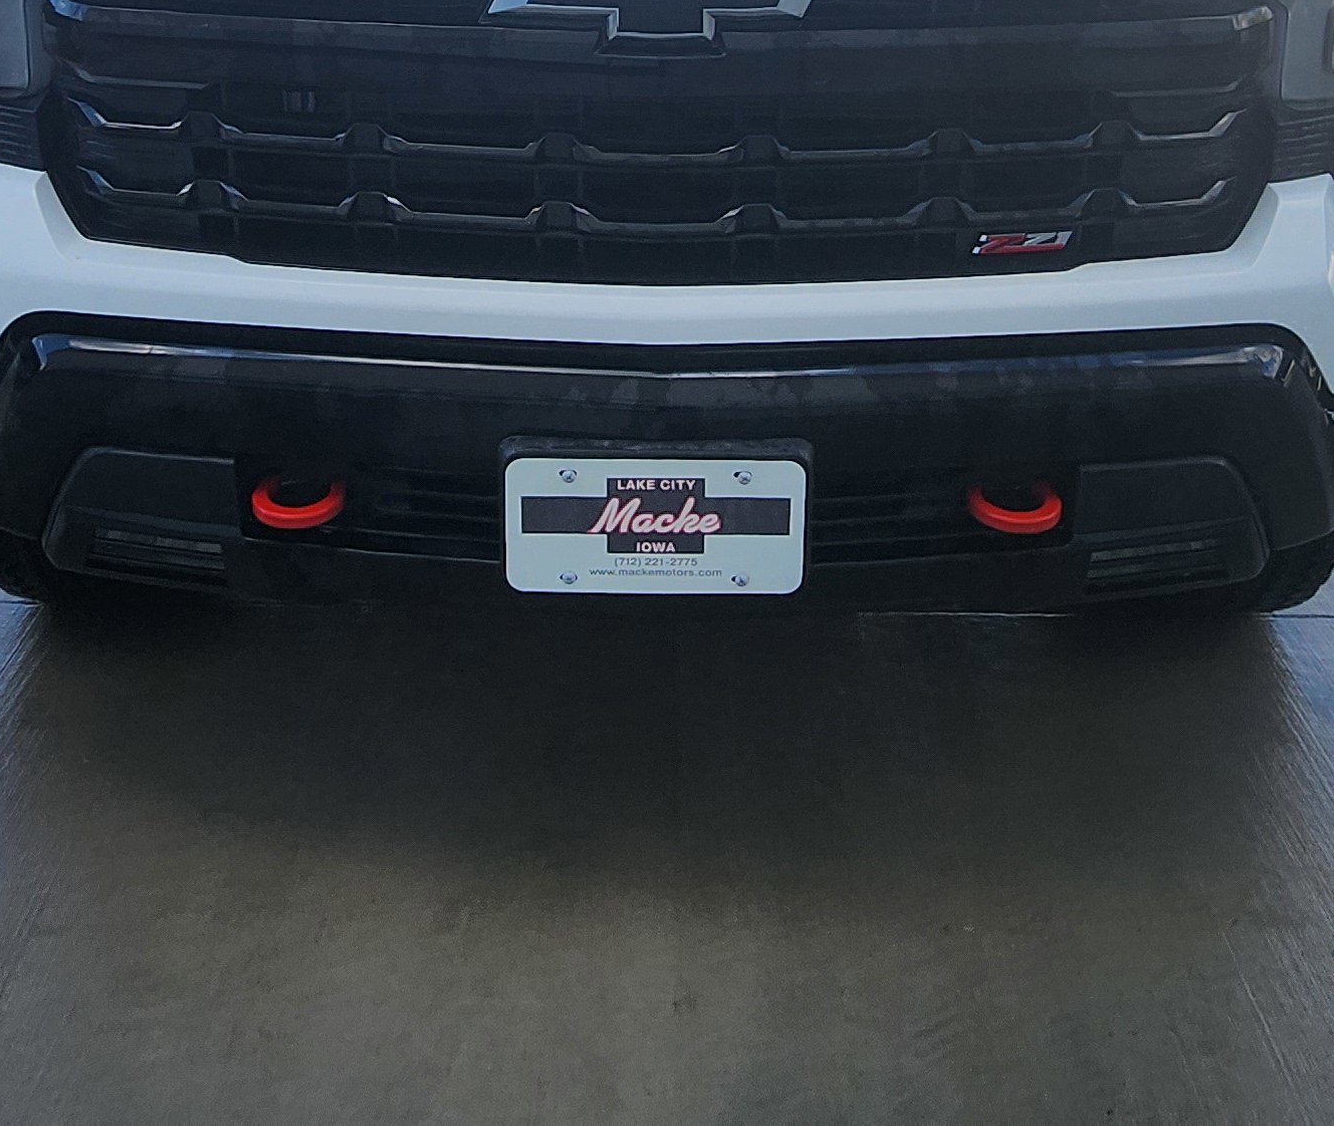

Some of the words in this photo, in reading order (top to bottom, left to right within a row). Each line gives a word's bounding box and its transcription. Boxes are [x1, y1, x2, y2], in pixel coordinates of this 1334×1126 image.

[616, 479, 656, 490] LAKE
[660, 479, 696, 490] CITY
[587, 496, 721, 535] Macke
[636, 541, 676, 553] IOWA
[614, 557, 642, 567] (712)
[589, 568, 723, 577] www.mackemotors.com
